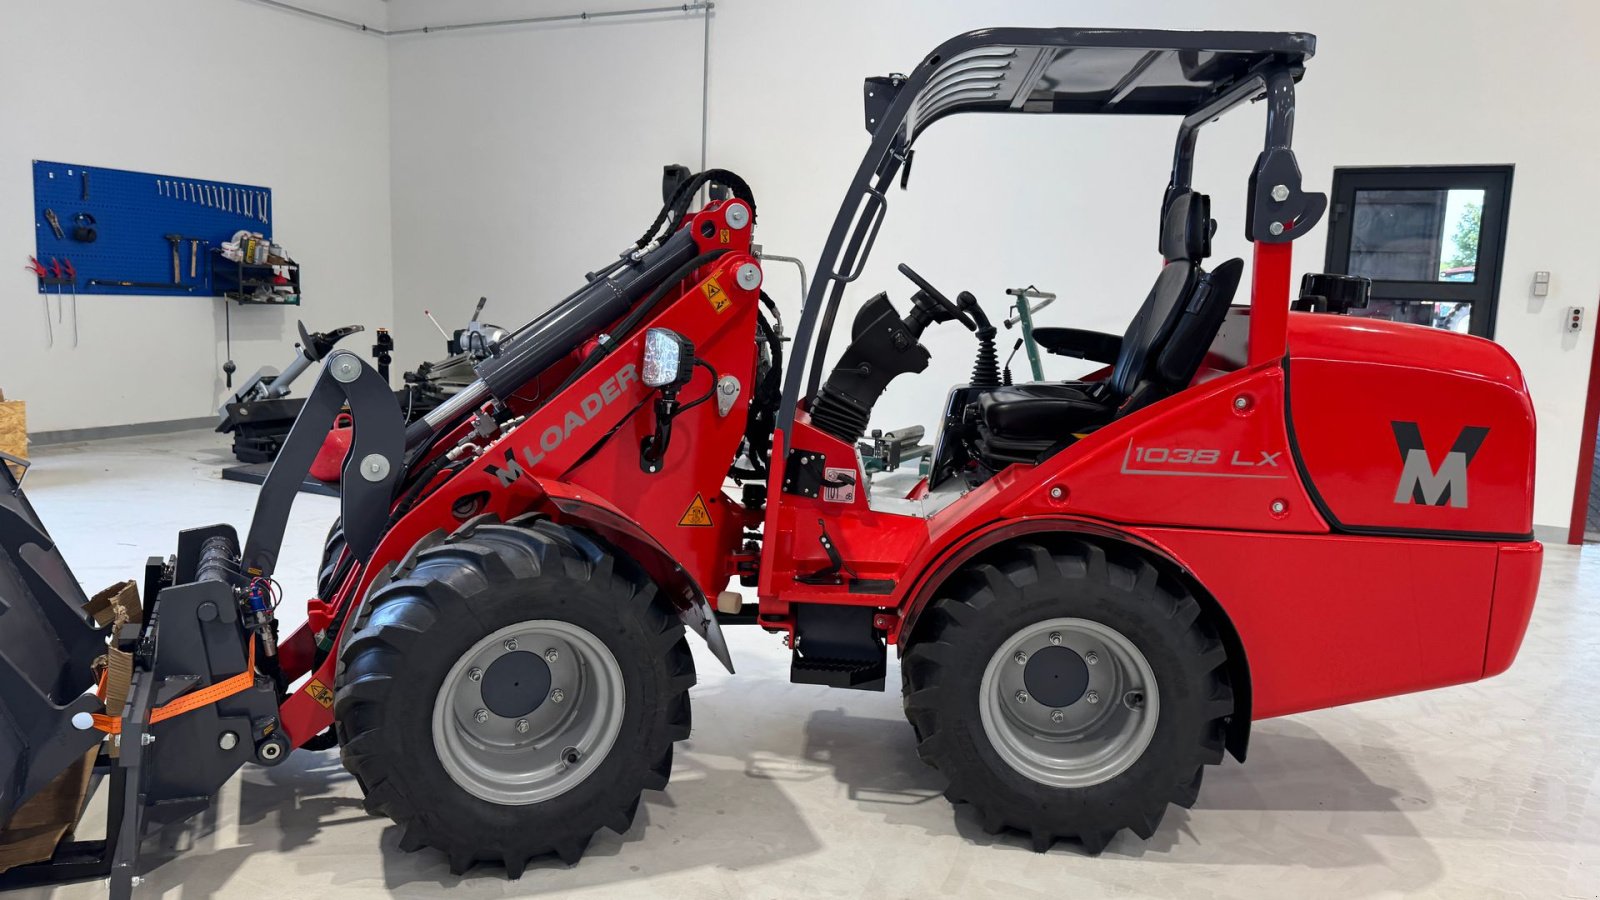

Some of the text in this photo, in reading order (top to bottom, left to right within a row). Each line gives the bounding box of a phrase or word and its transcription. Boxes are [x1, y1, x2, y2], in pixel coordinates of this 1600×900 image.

[523, 363, 639, 468] LOADER
[1136, 447, 1283, 467] 1038 LX
